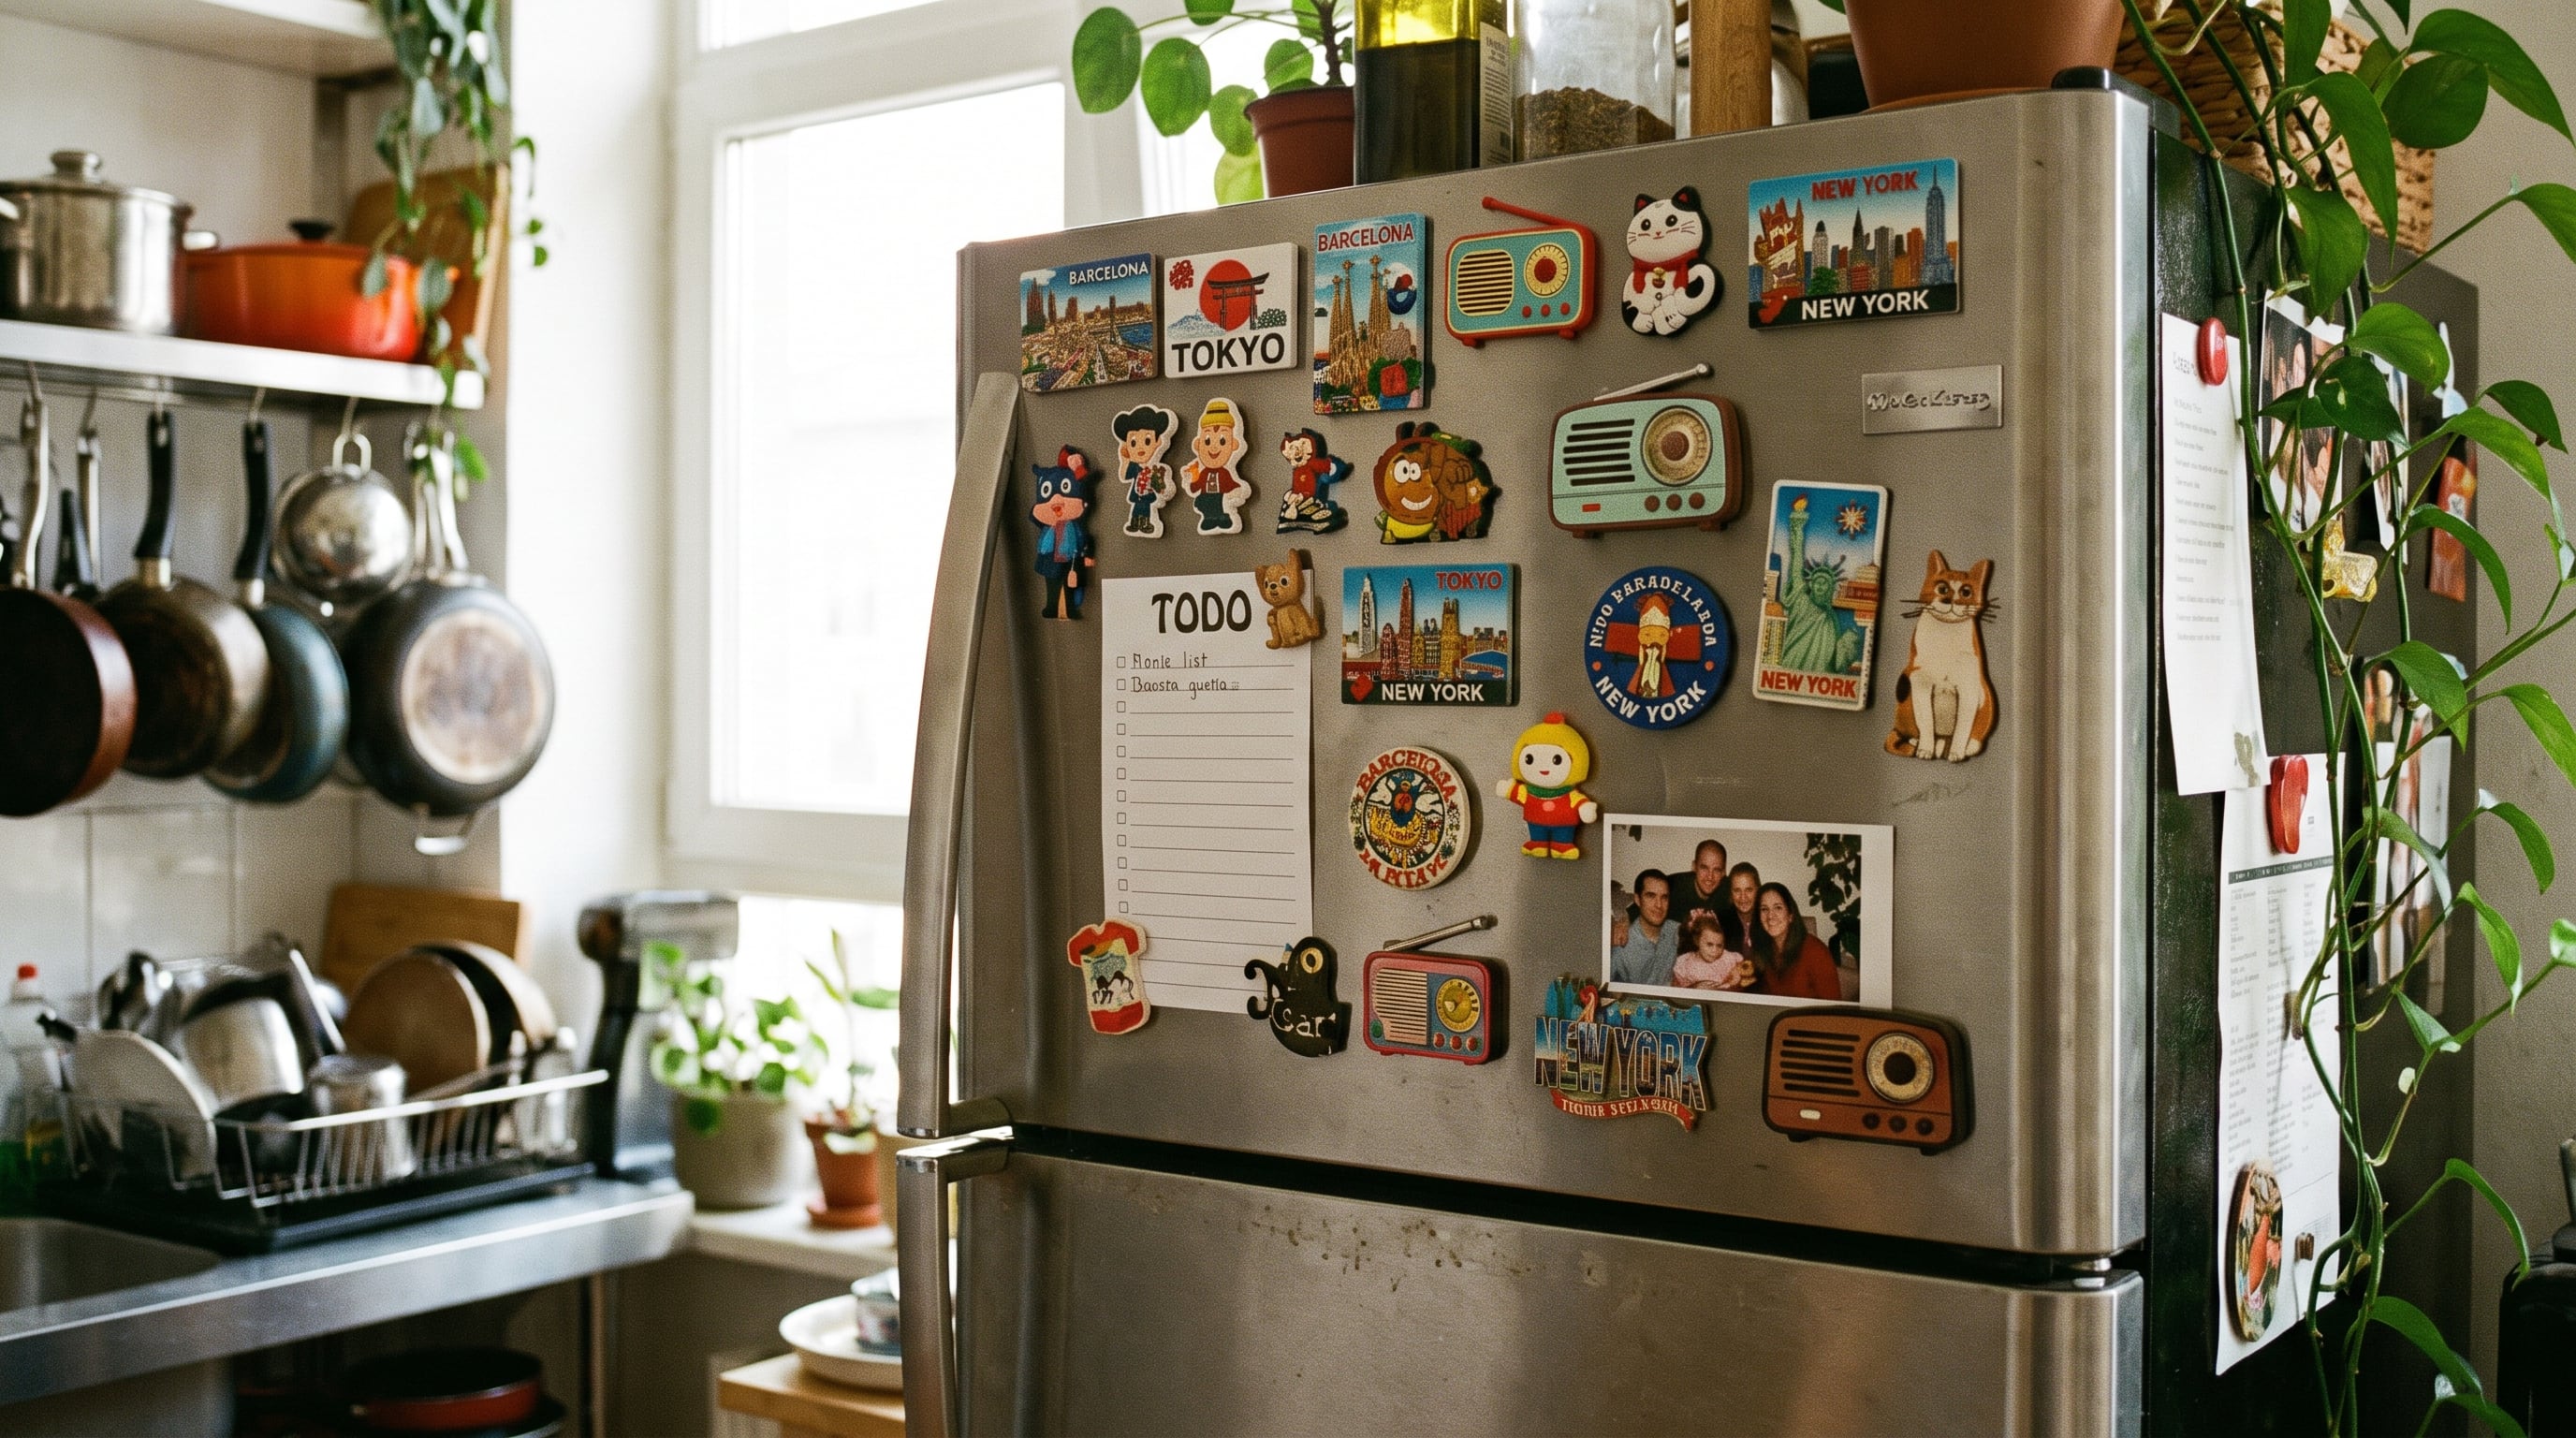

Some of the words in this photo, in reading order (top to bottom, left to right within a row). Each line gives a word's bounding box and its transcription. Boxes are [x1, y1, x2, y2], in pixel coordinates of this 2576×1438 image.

[1811, 177, 1856, 201] NEW
[1862, 169, 1918, 195] YORK
[1317, 223, 1414, 252] BARCELONA
[1069, 261, 1149, 286] BARCELONA
[1801, 297, 1856, 320] NEW
[1862, 289, 1929, 315] YORK
[1171, 332, 1285, 373] TOKYO
[1436, 570, 1502, 591] TOKYO
[1151, 590, 1251, 634] TODO
[1183, 651, 1208, 668] list
[1382, 683, 1424, 701] NEW
[1430, 683, 1485, 701] YORK
[1760, 669, 1804, 692] NEW
[1807, 675, 1857, 698] YORK
[1595, 675, 1640, 719] NEW
[1646, 680, 1706, 724] YORK
[1534, 1017, 1609, 1094] NEW
[1613, 1026, 1708, 1111] YORK
